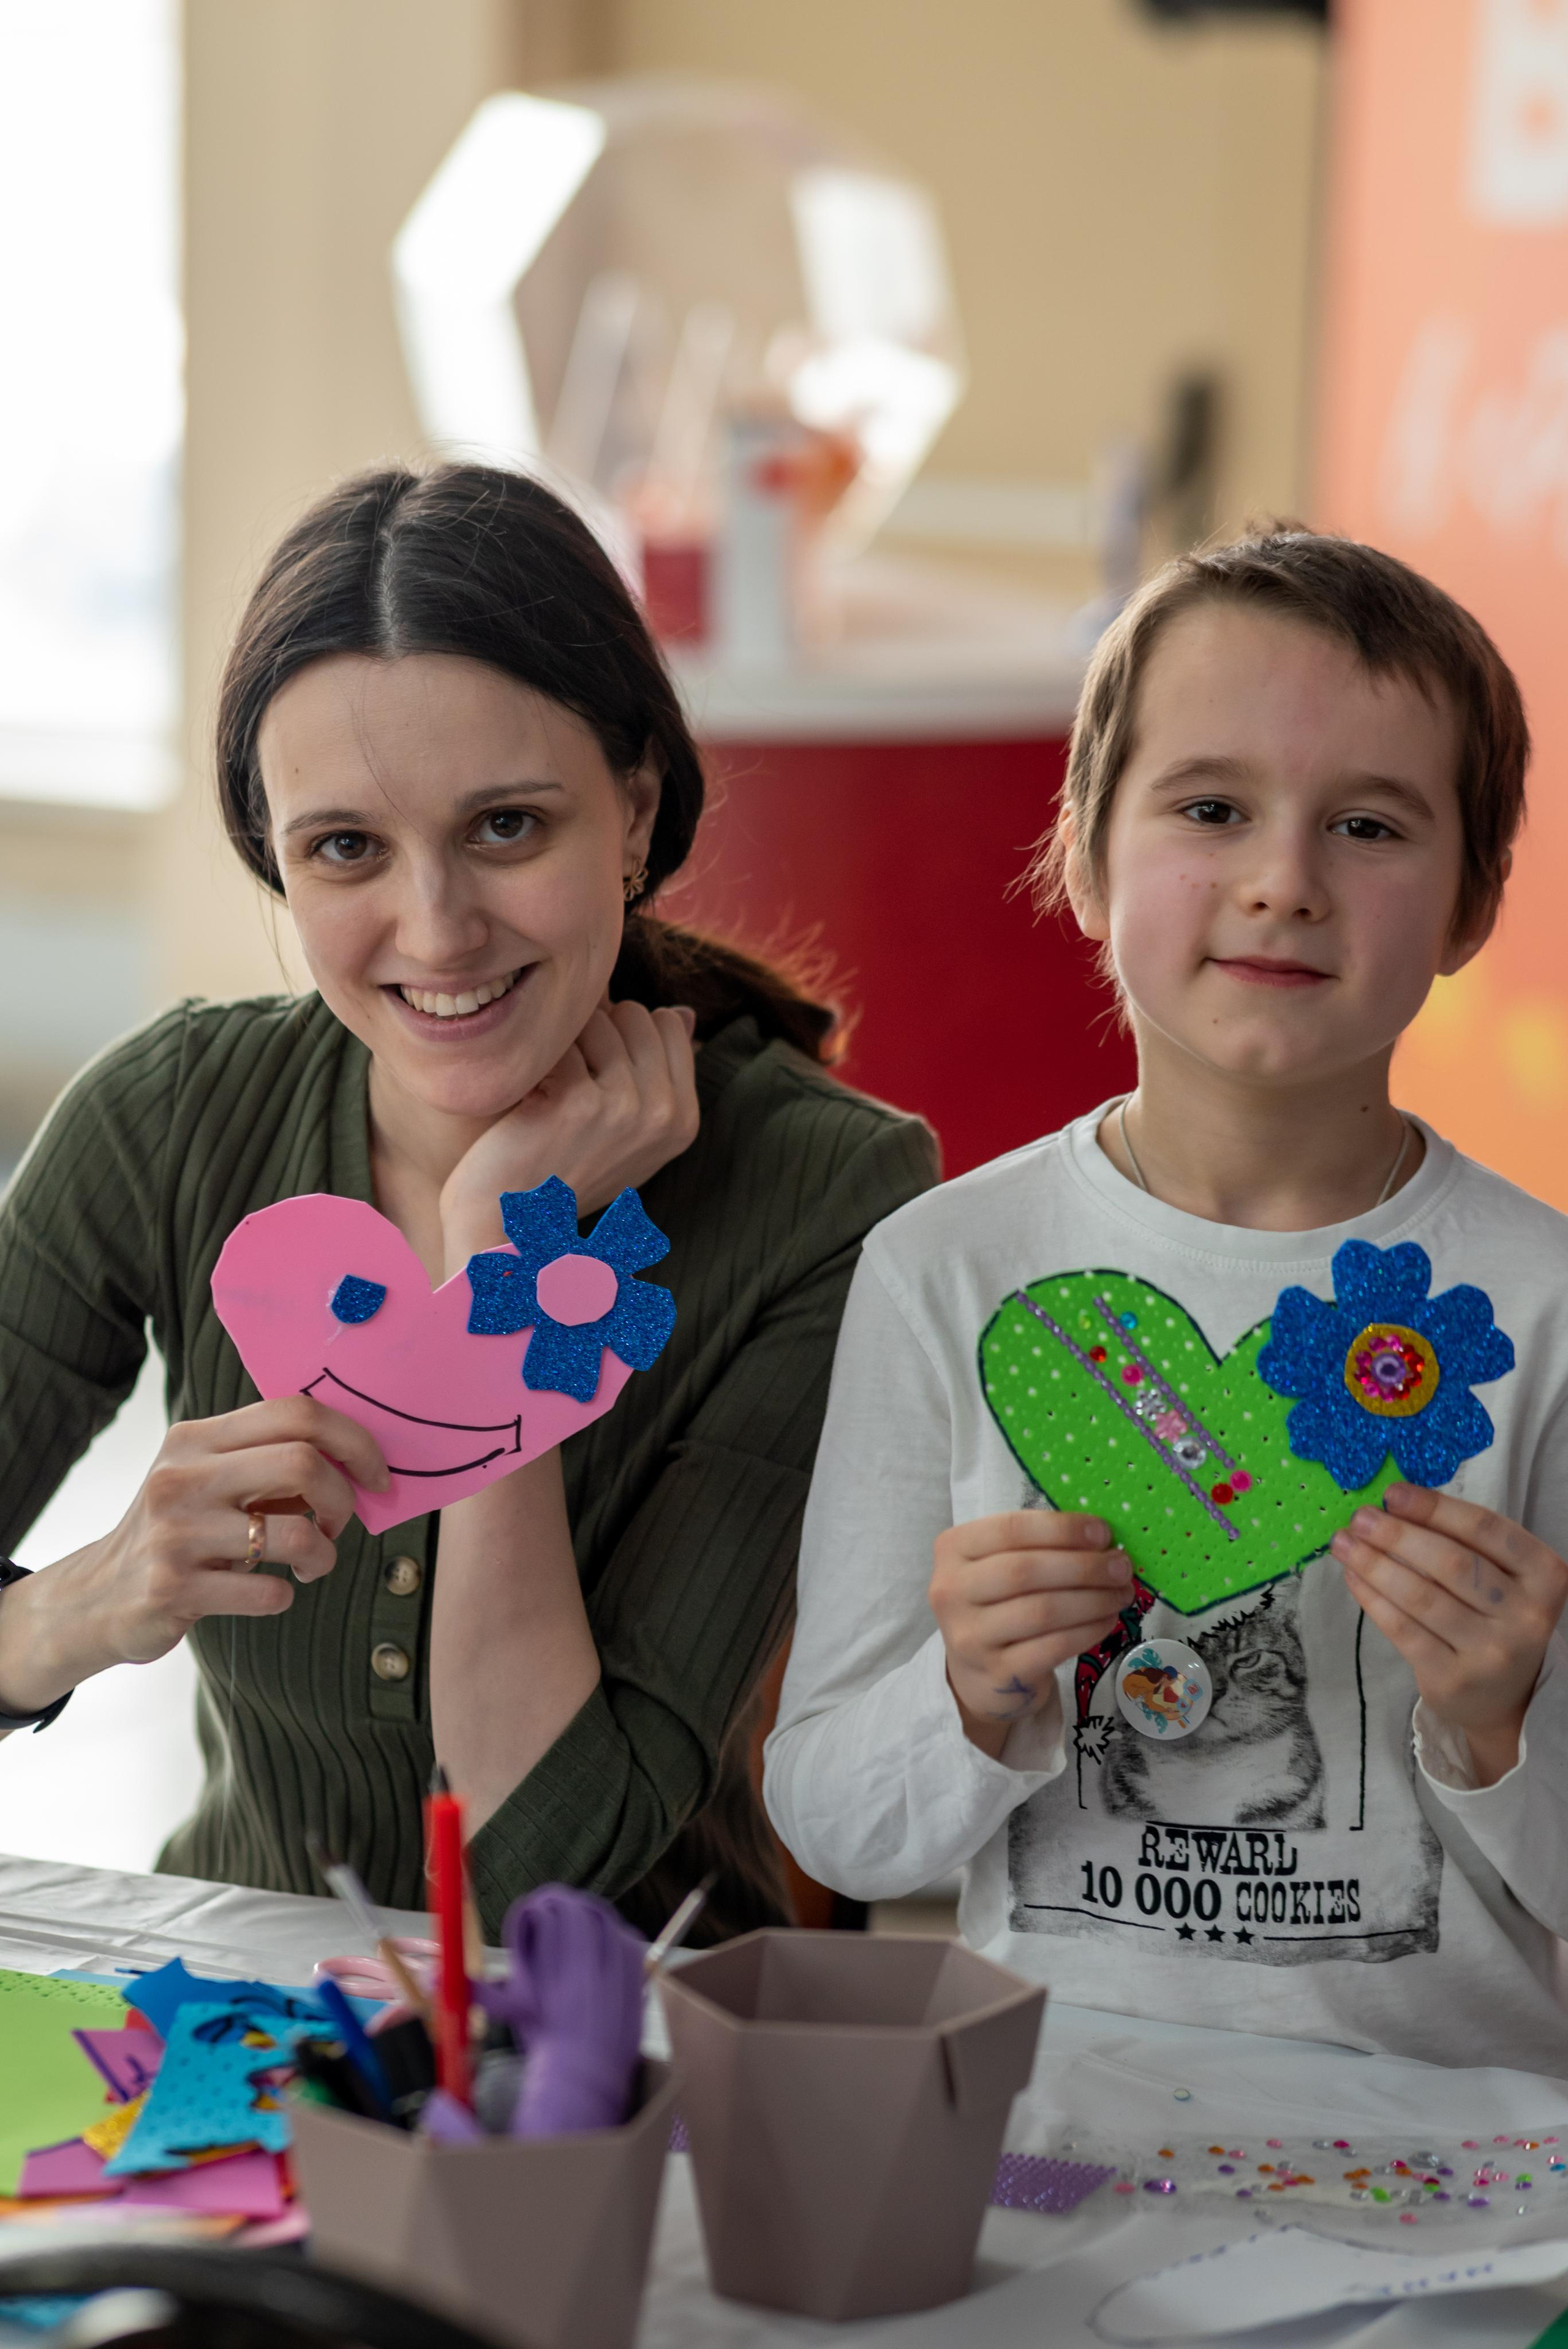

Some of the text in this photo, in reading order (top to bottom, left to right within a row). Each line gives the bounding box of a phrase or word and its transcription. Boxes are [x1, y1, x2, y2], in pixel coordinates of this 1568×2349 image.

[1080, 1860, 1361, 1924] 10 000 COOKIES
